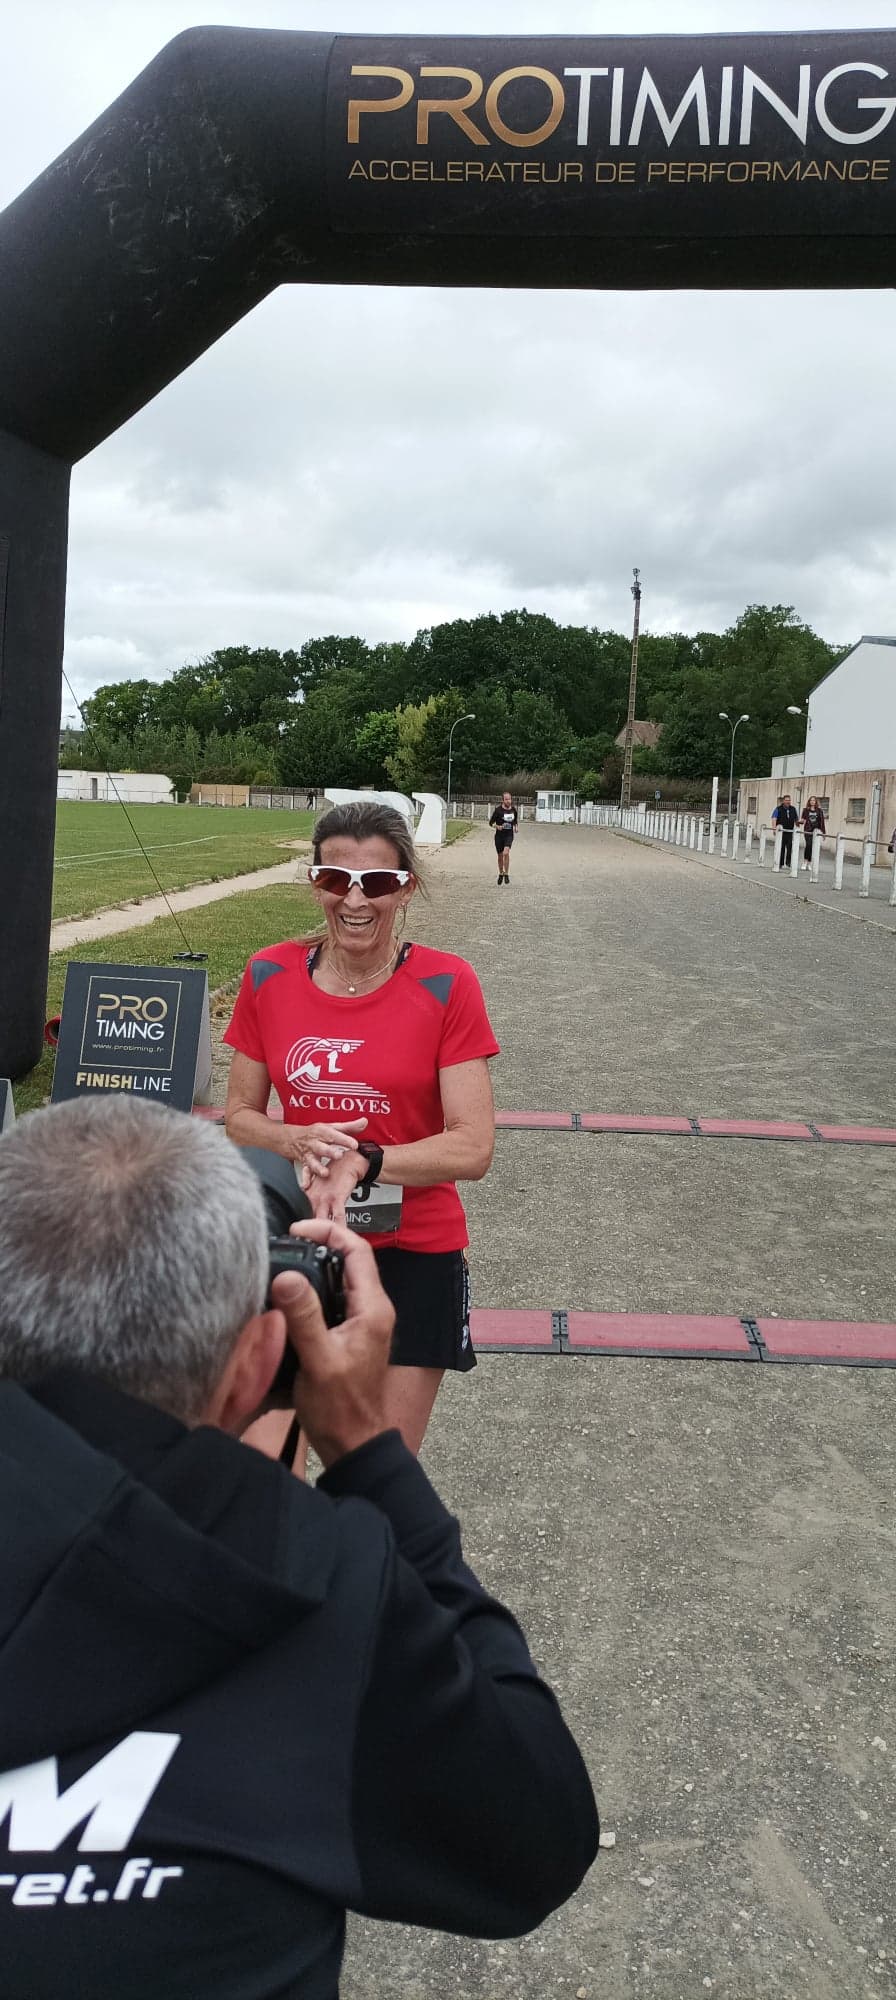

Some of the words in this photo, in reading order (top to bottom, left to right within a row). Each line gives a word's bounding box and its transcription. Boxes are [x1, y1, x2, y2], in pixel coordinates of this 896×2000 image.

[347, 62, 896, 147] PROTIMING
[348, 159, 583, 183] ACCELERATEUR
[596, 162, 635, 183] DE
[648, 159, 890, 183] PERFORMANCE
[96, 993, 168, 1022] PRO
[96, 1019, 165, 1040] TIMING
[92, 1043, 164, 1053] www.protiming.fr
[289, 1094, 311, 1108] AC
[315, 1096, 391, 1114] CLOYES
